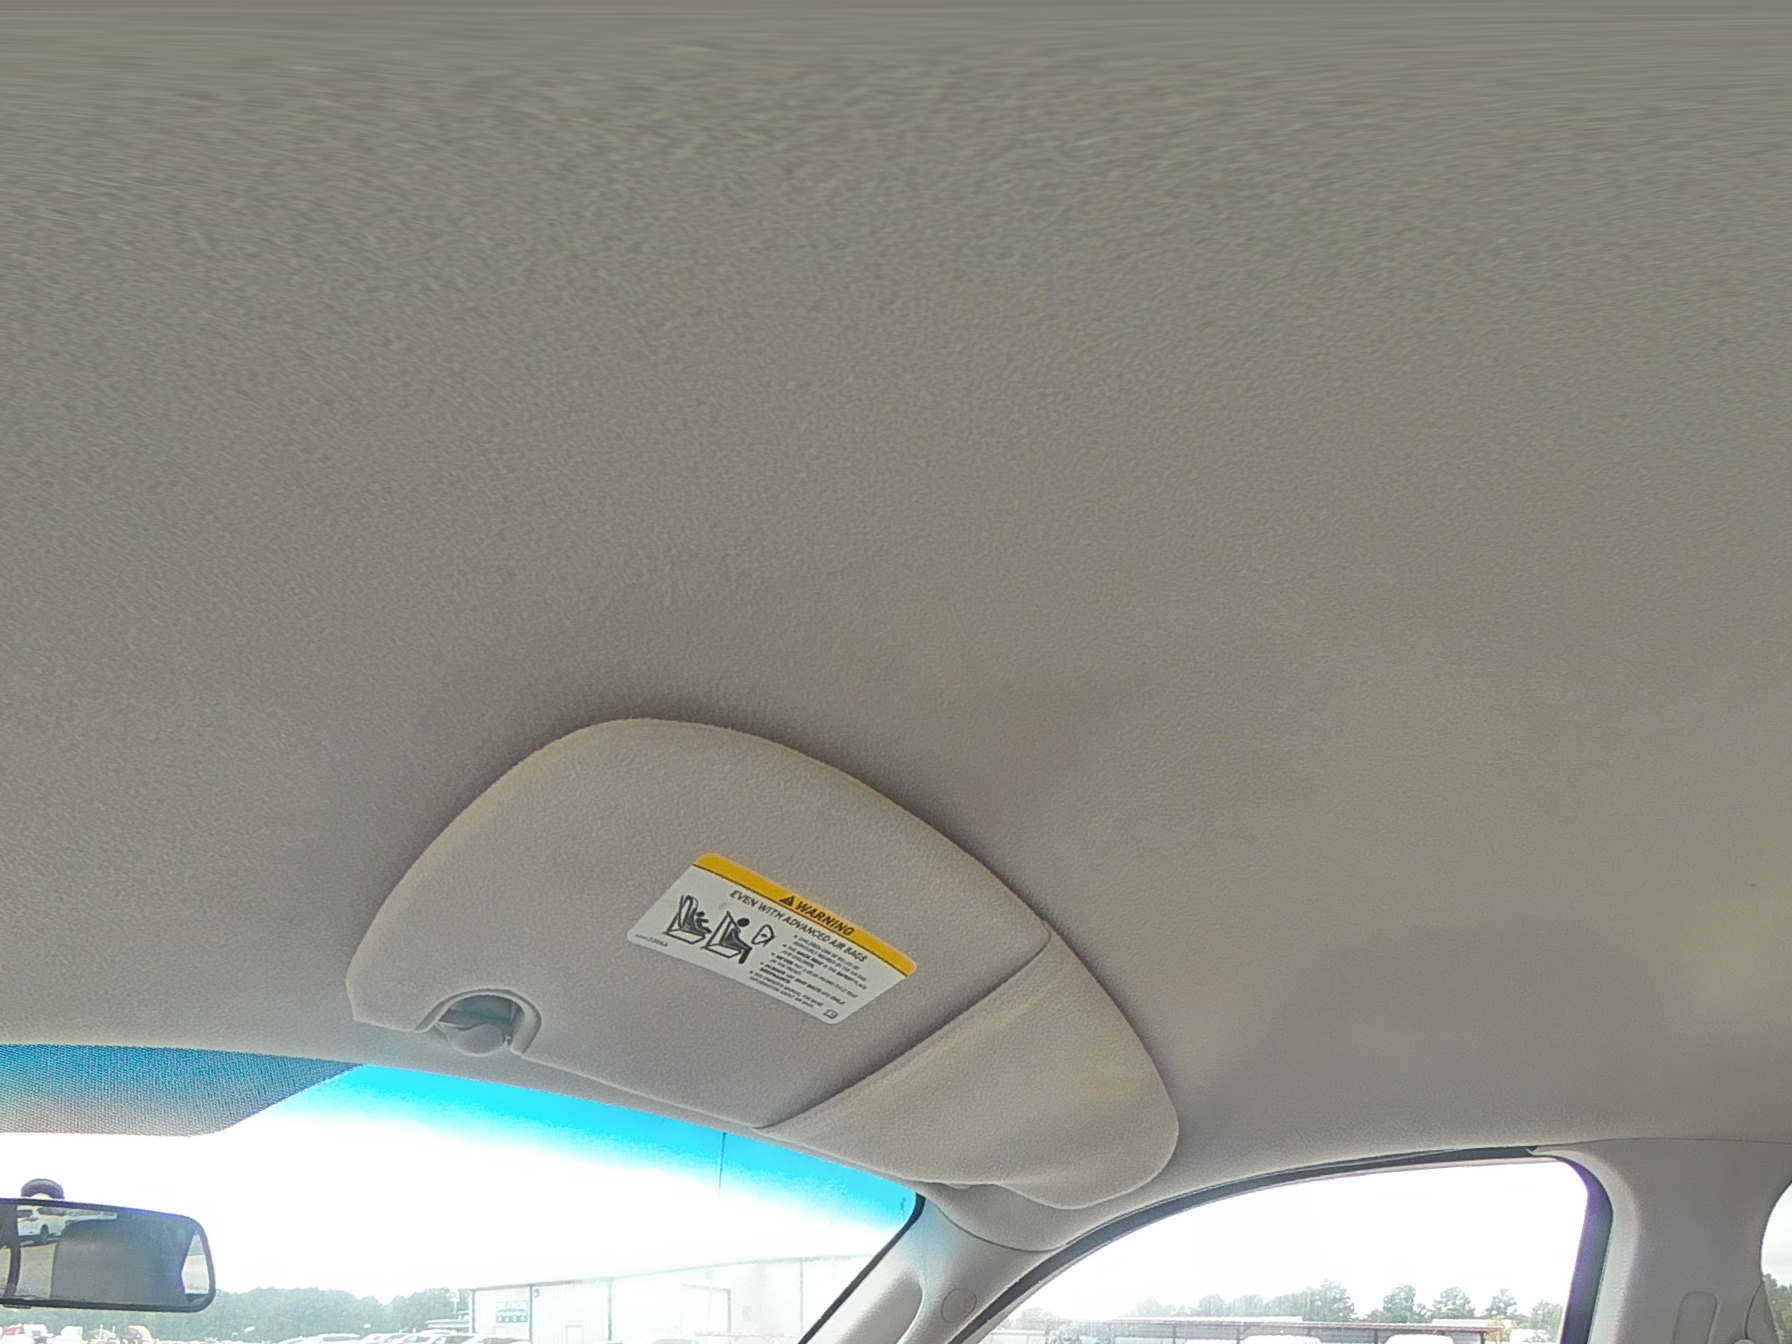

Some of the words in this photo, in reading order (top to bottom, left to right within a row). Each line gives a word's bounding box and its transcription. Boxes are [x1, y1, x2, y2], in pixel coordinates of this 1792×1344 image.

[729, 890, 759, 908] EVEN
[758, 902, 786, 919] WITH
[783, 916, 832, 943] ADVANCED
[829, 939, 850, 951] AIR
[844, 947, 868, 963] BAGS
[795, 901, 856, 936] WARNING
